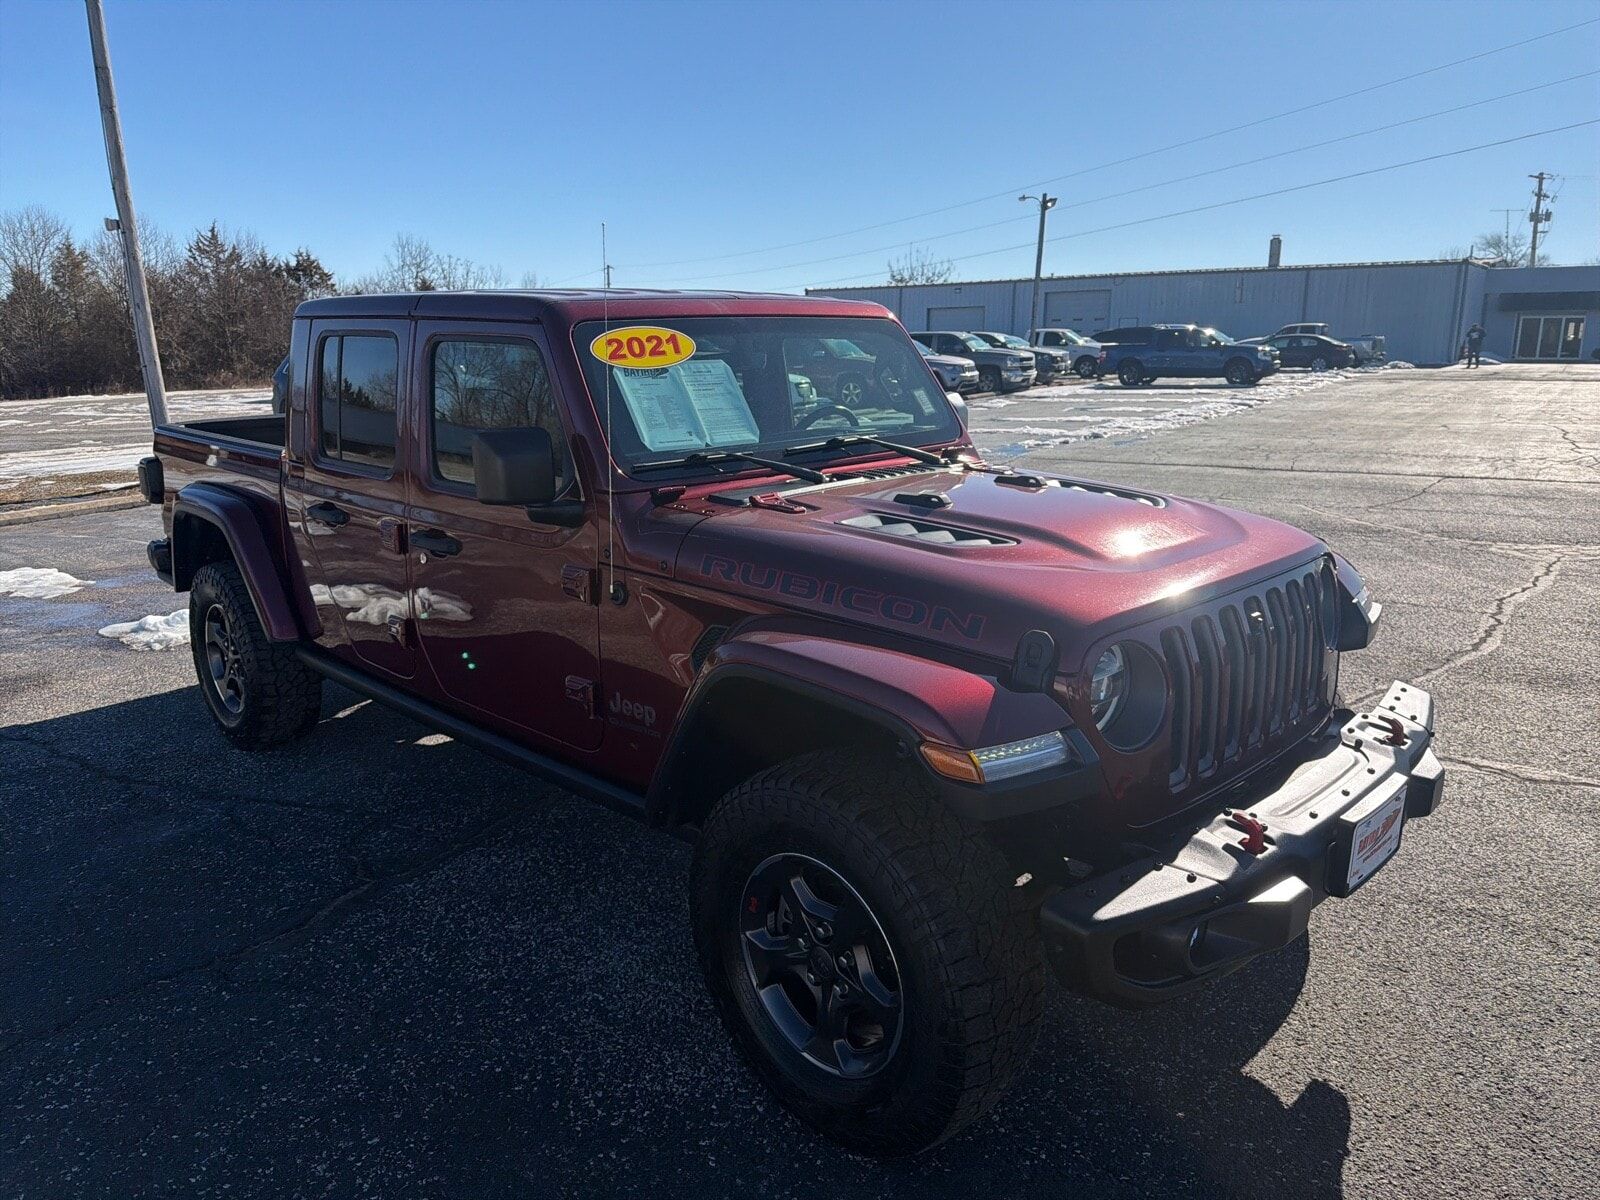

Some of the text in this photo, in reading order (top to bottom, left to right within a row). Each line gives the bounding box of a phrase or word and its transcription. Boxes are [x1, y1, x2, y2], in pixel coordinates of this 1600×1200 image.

[607, 334, 682, 361] 2021
[700, 554, 987, 641] RUBICON
[609, 692, 656, 727] Jeep
